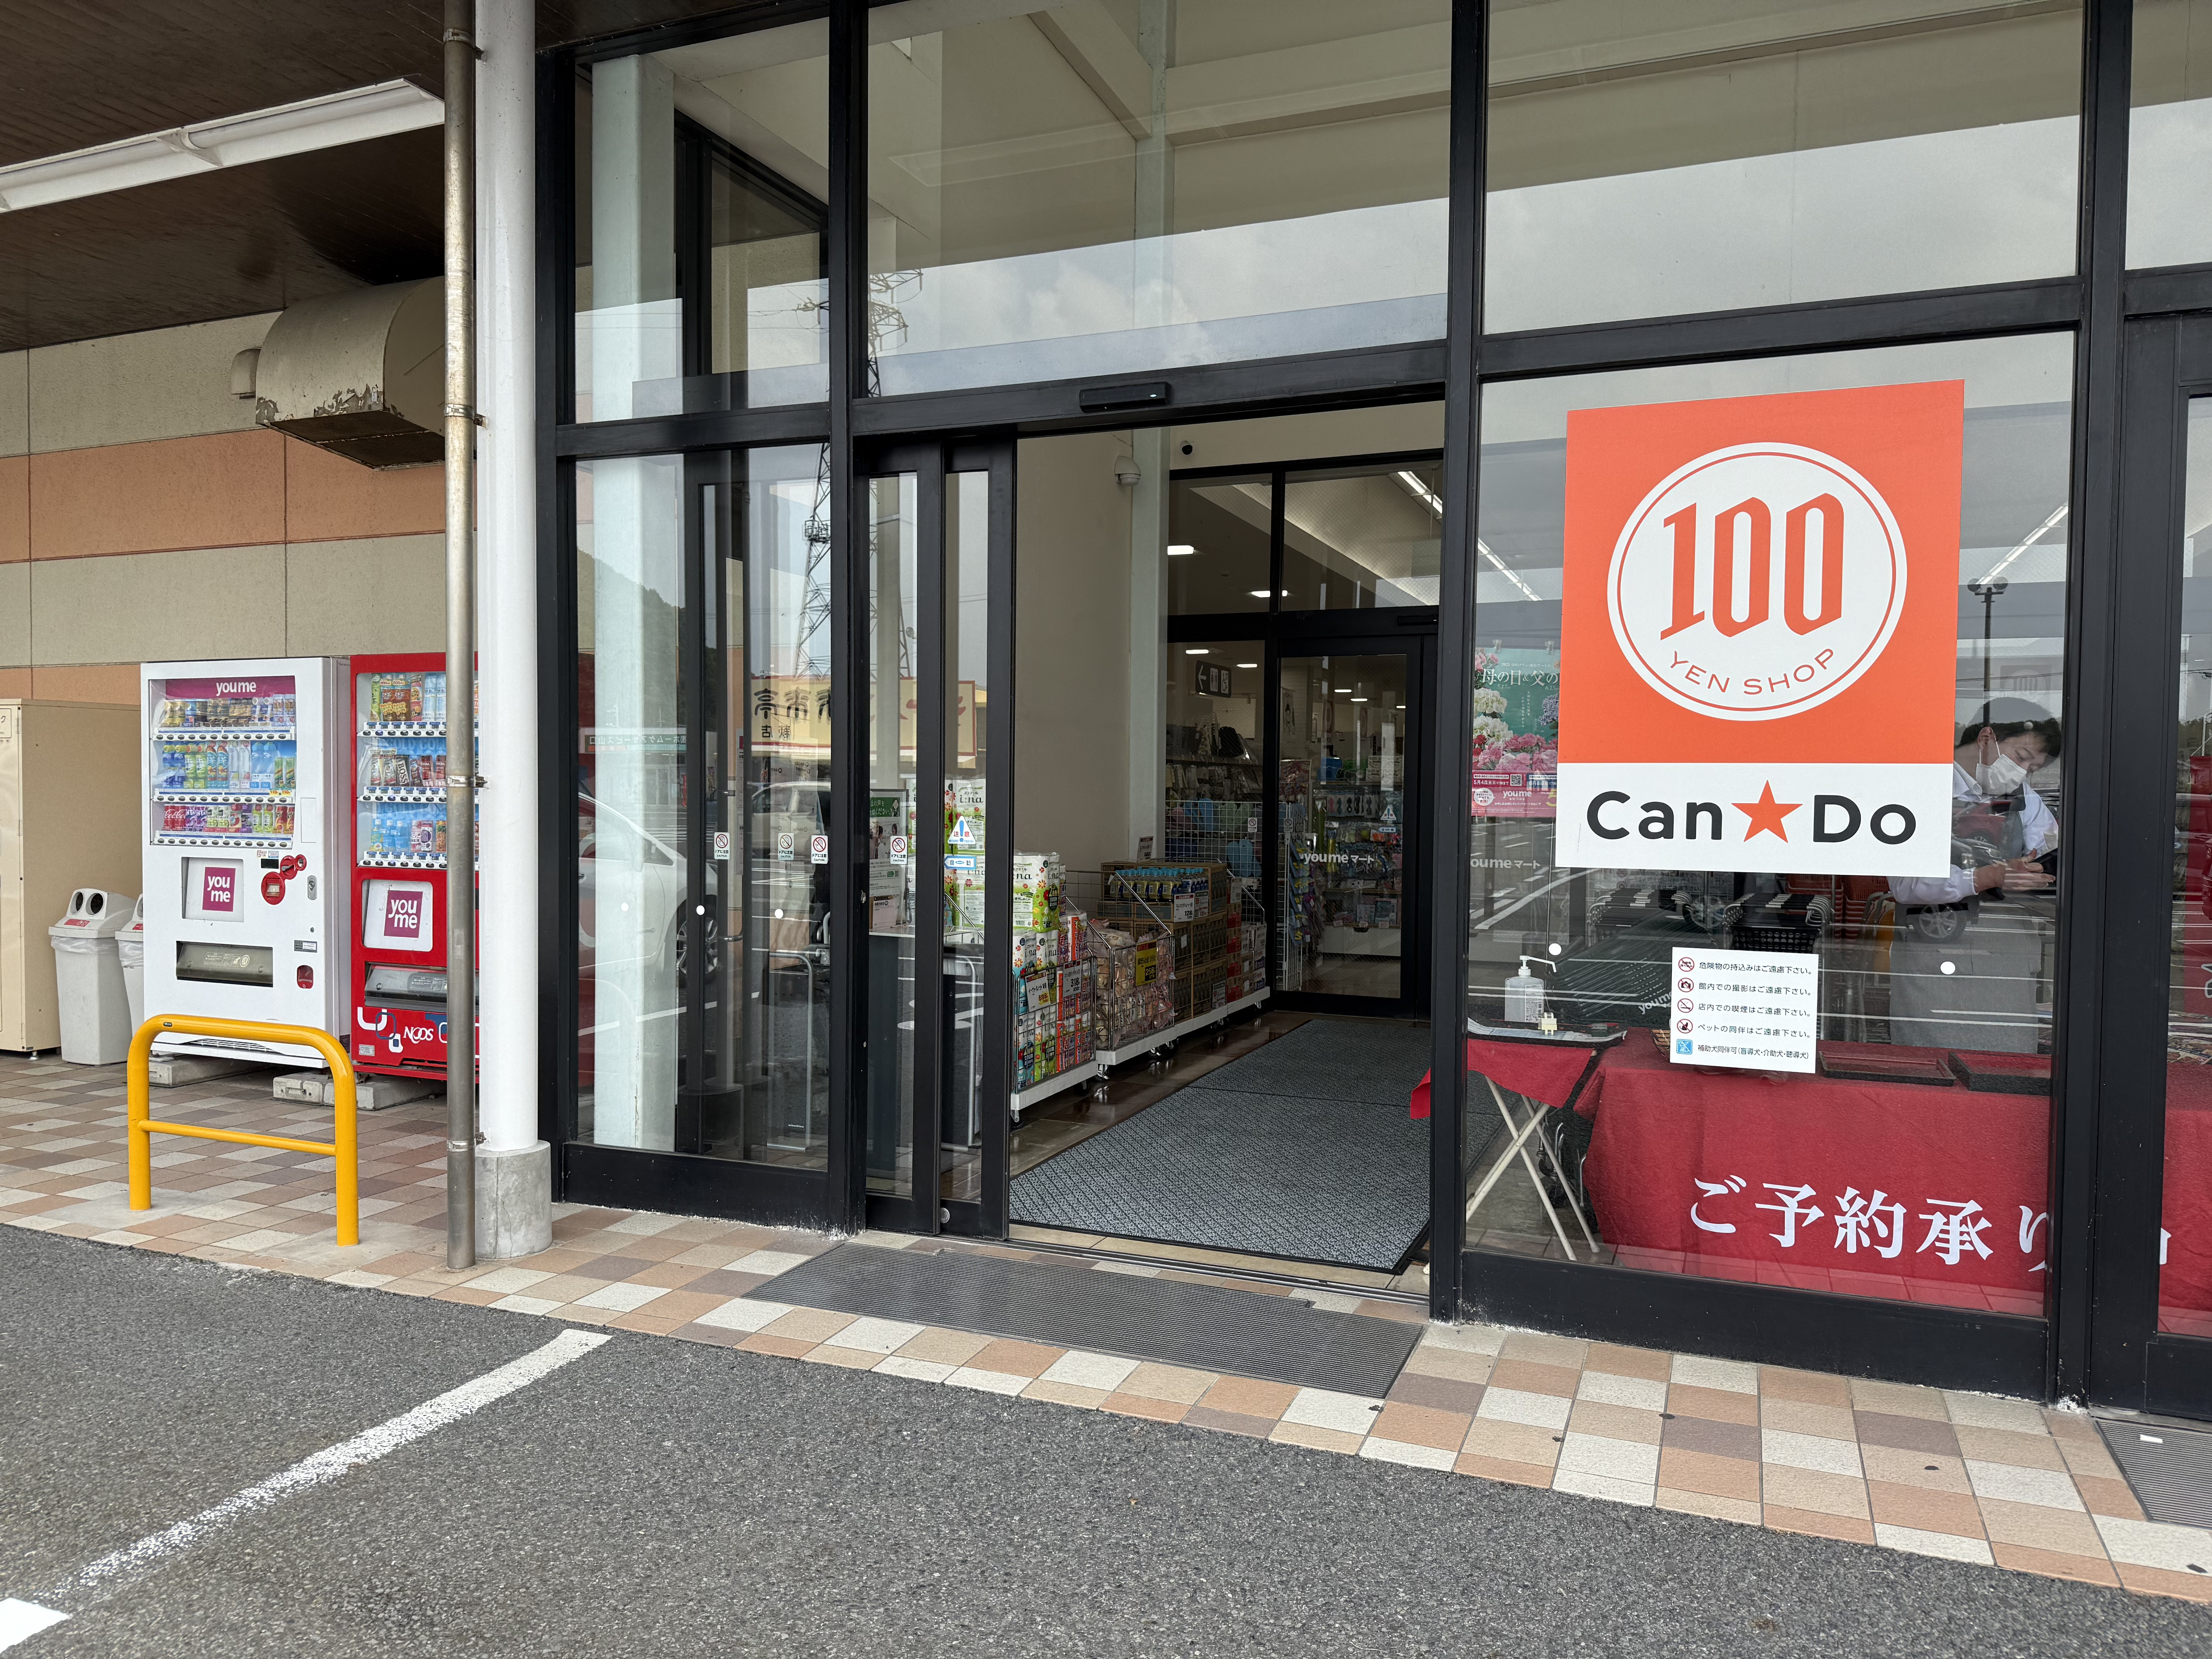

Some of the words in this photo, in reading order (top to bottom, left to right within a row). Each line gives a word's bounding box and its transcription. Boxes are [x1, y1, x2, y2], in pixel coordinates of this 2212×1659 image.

[1659, 492, 1845, 641] 100
[1670, 649, 1730, 694] YEN
[1743, 647, 1834, 695] SHOP
[398, 763, 408, 785] BOSS
[1587, 790, 1723, 840] Can
[1812, 795, 1917, 845] Do
[1351, 854, 1374, 864] マート
[1515, 860, 1540, 869] マート
[207, 876, 230, 891] you
[211, 890, 230, 902] me
[388, 897, 417, 919] you
[394, 913, 418, 930] me
[1699, 961, 1812, 975] 危険物の持込みはご遠慮下さい。
[1071, 977, 1079, 987] 318
[1698, 982, 1811, 996] 館内での撮影はご遠慮下さい。
[1698, 1003, 1811, 1017] 店内での喫煙はご遠慮下さい。
[1698, 1024, 1810, 1039] ペットの同伴はご遠慮下さい。
